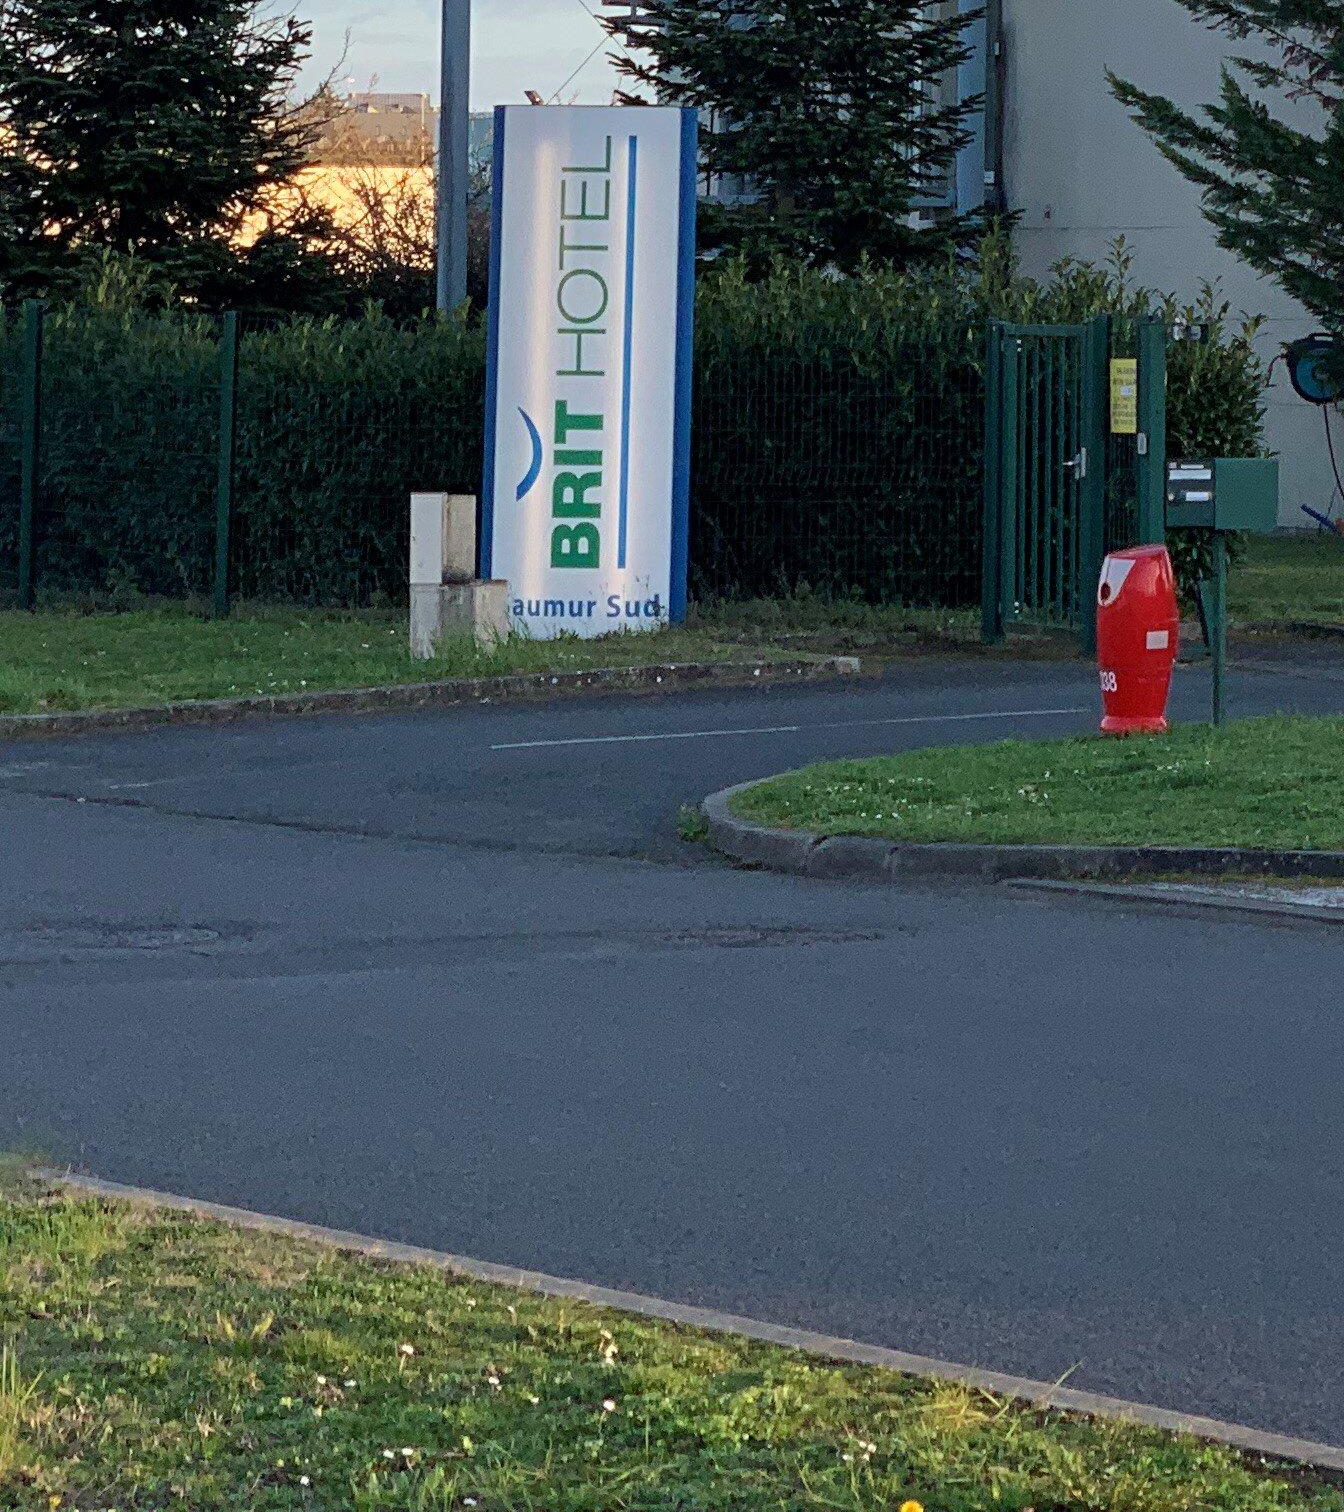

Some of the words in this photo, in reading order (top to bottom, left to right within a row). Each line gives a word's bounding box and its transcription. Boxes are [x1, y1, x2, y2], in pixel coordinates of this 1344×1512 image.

[556, 135, 612, 376] HOTEL
[551, 400, 604, 569] BRIT
[510, 597, 597, 618] aumur
[606, 594, 661, 618] Sud
